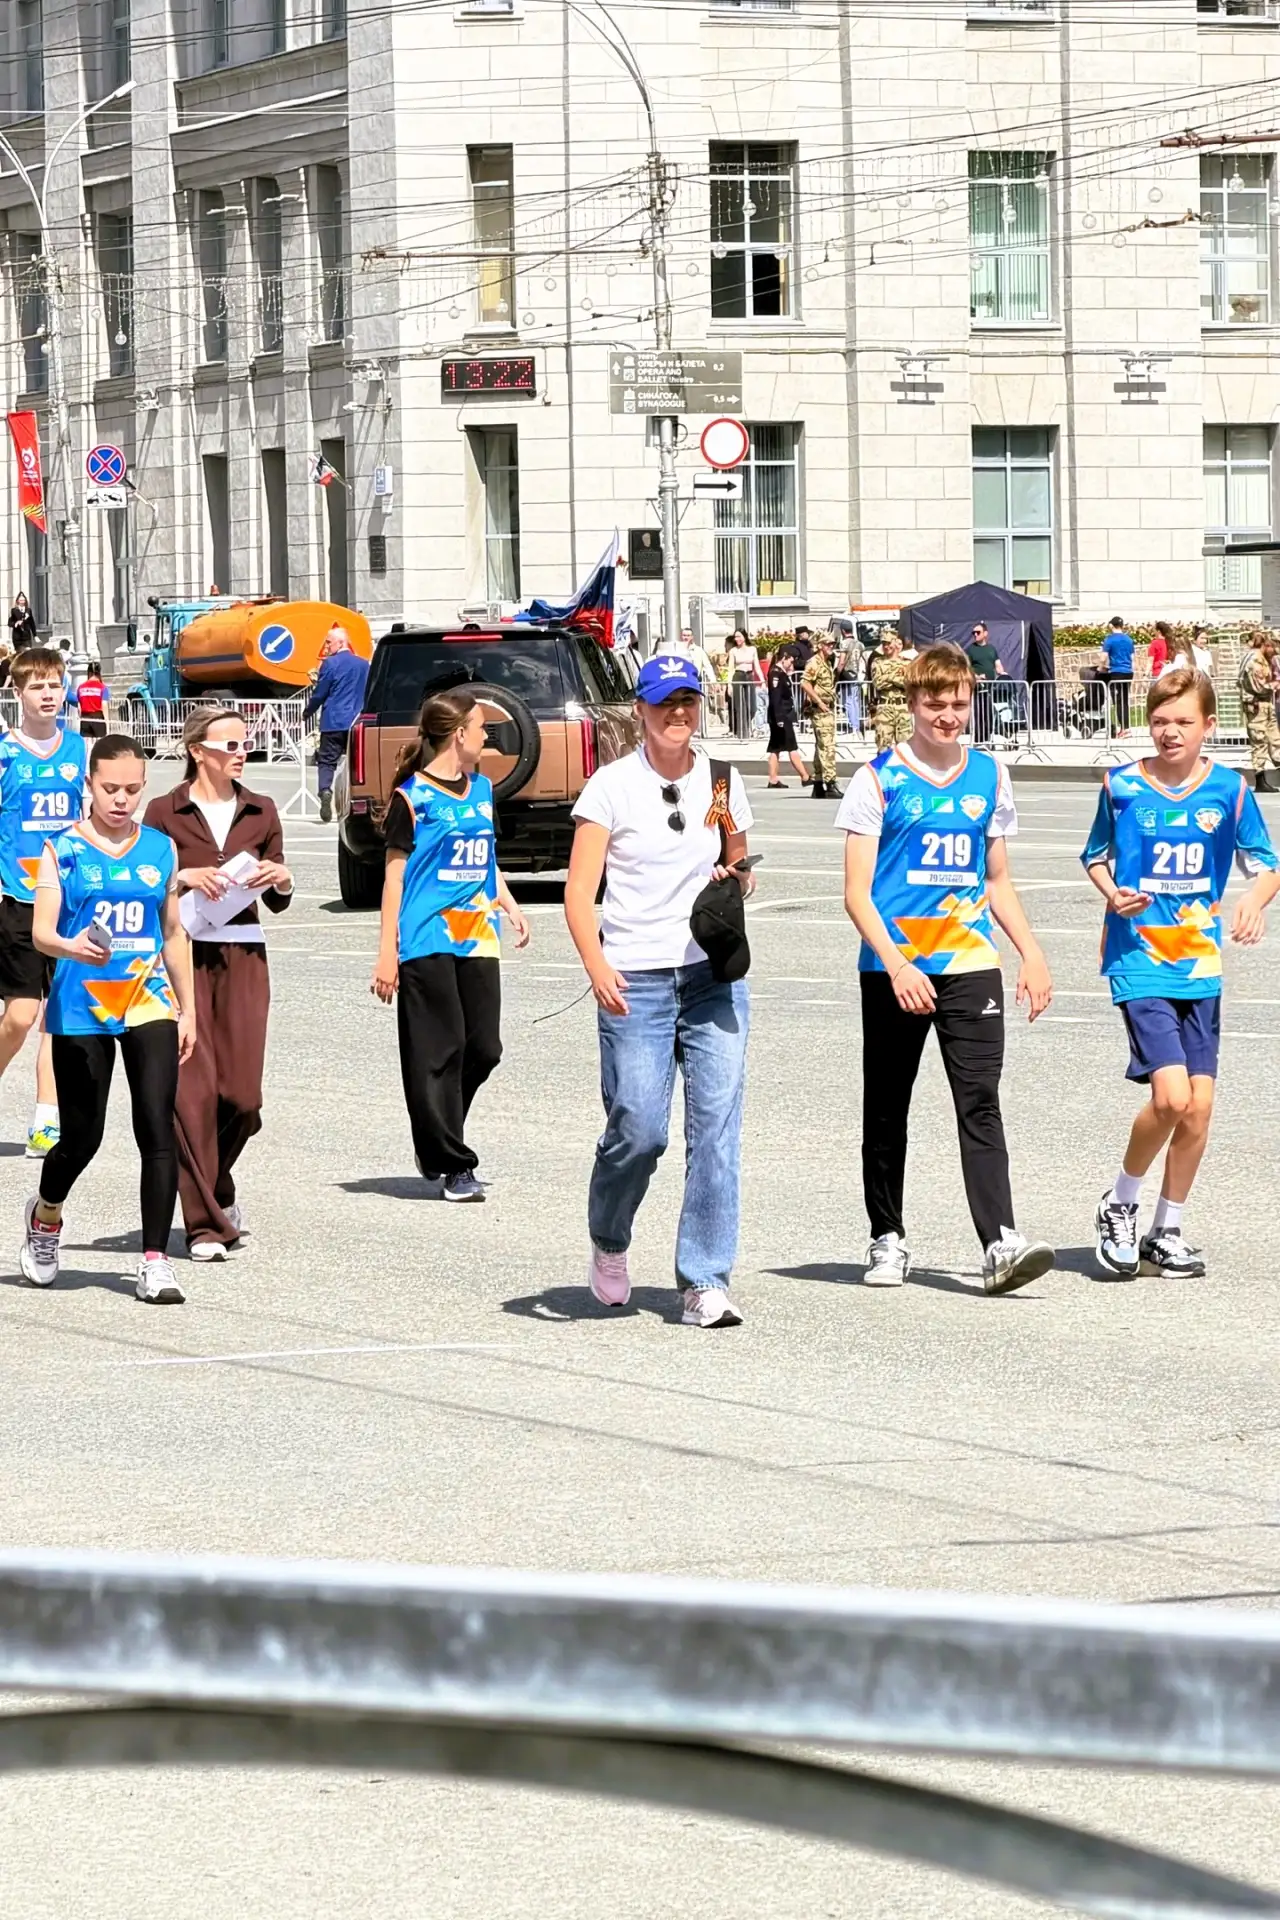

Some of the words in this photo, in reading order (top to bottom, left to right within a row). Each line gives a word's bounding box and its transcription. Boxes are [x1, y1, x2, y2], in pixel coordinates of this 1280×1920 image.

[637, 360, 667, 368] ОПЕРЫ
[675, 360, 706, 368] БАЛЕТА
[637, 368, 665, 376] OPERA
[665, 368, 682, 376] AND
[637, 392, 679, 400] СИНАГОГА
[637, 400, 687, 408] SYNAGOGUE
[31, 791, 69, 817] 219
[450, 838, 489, 866] 219
[921, 832, 972, 867] 219
[1152, 841, 1205, 875] 219
[92, 900, 145, 937] 219
